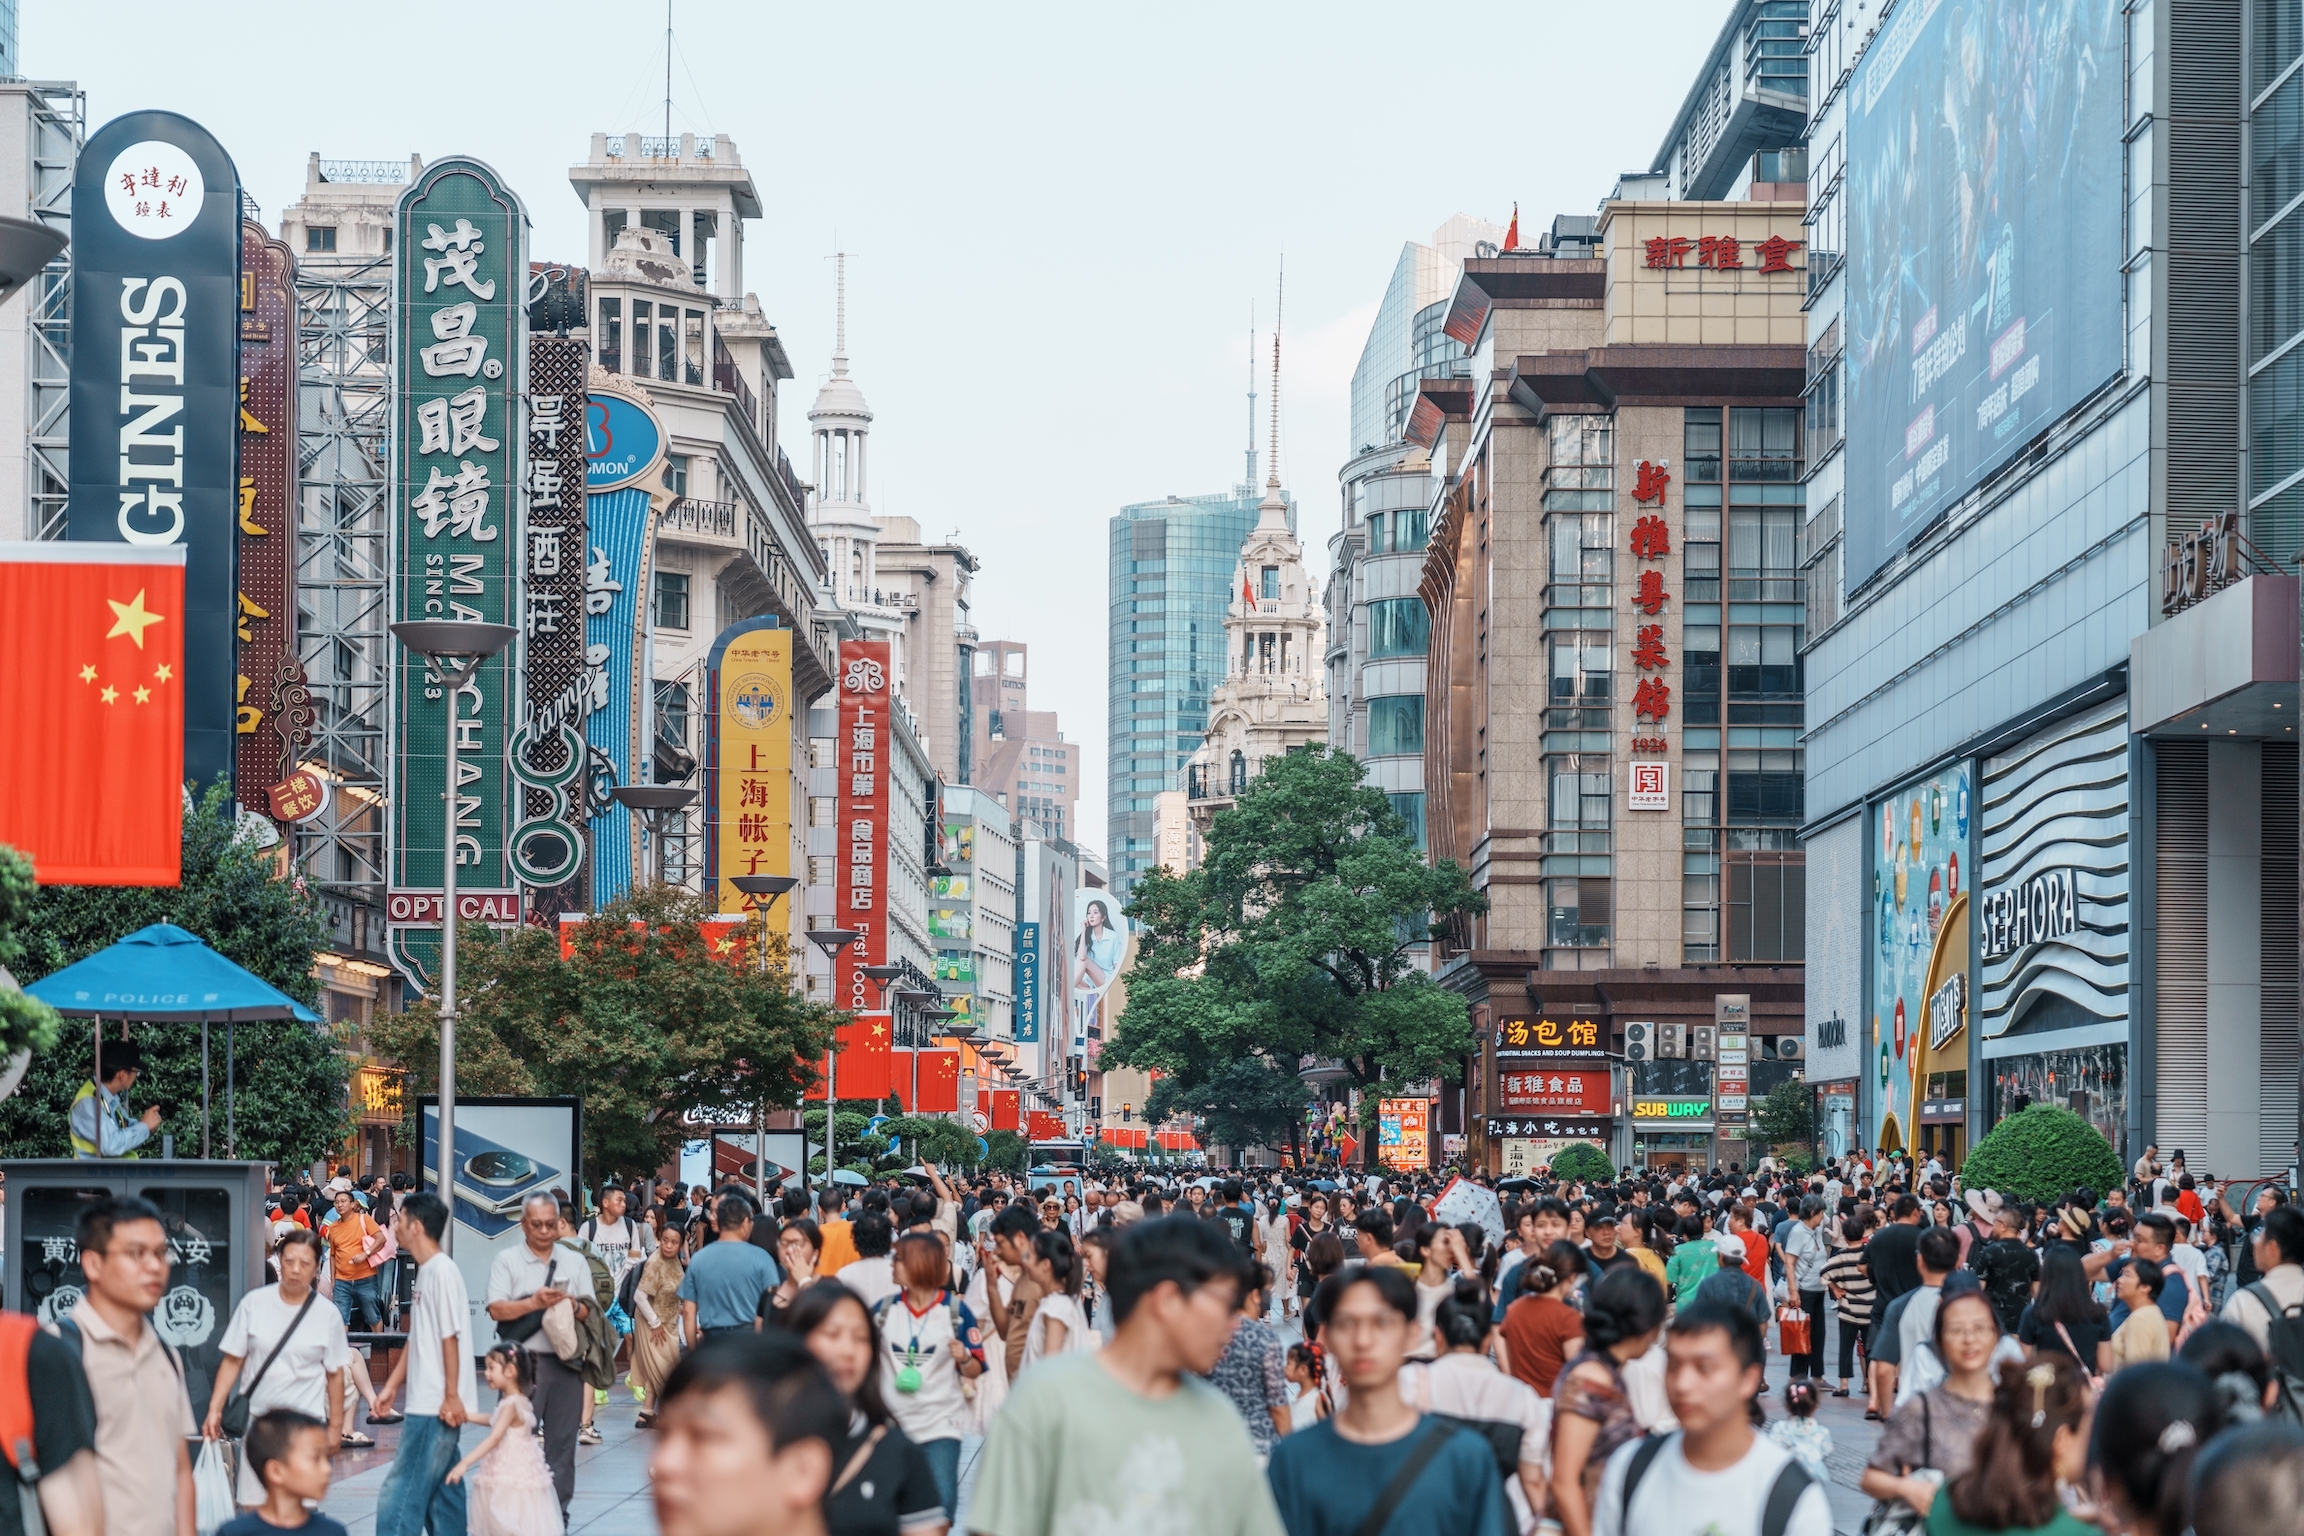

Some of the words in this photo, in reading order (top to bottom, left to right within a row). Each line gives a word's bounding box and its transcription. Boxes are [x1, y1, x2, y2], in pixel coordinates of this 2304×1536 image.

[411, 218, 500, 542] 茂昌眼镜
[117, 275, 188, 546] GINES
[426, 554, 443, 621] SINC
[1001, 679, 1026, 691] EDITION
[1631, 737, 1668, 754] 1926
[274, 775, 309, 802] 二楼
[281, 792, 317, 820] 餐饮
[850, 705, 875, 911] 上海市第一食品商店
[390, 896, 516, 920] OPTCAL
[1981, 868, 2079, 958] SEPHORA
[853, 922, 869, 957] First
[104, 993, 190, 1005] POLICE
[1507, 1019, 1598, 1046] 汤包馆
[1818, 1017, 1847, 1049] PANDORA
[1507, 1075, 1583, 1094] 新雅食品
[1633, 1101, 1709, 1117] SUBWAY
[1565, 1126, 1600, 1135] 汤包馆
